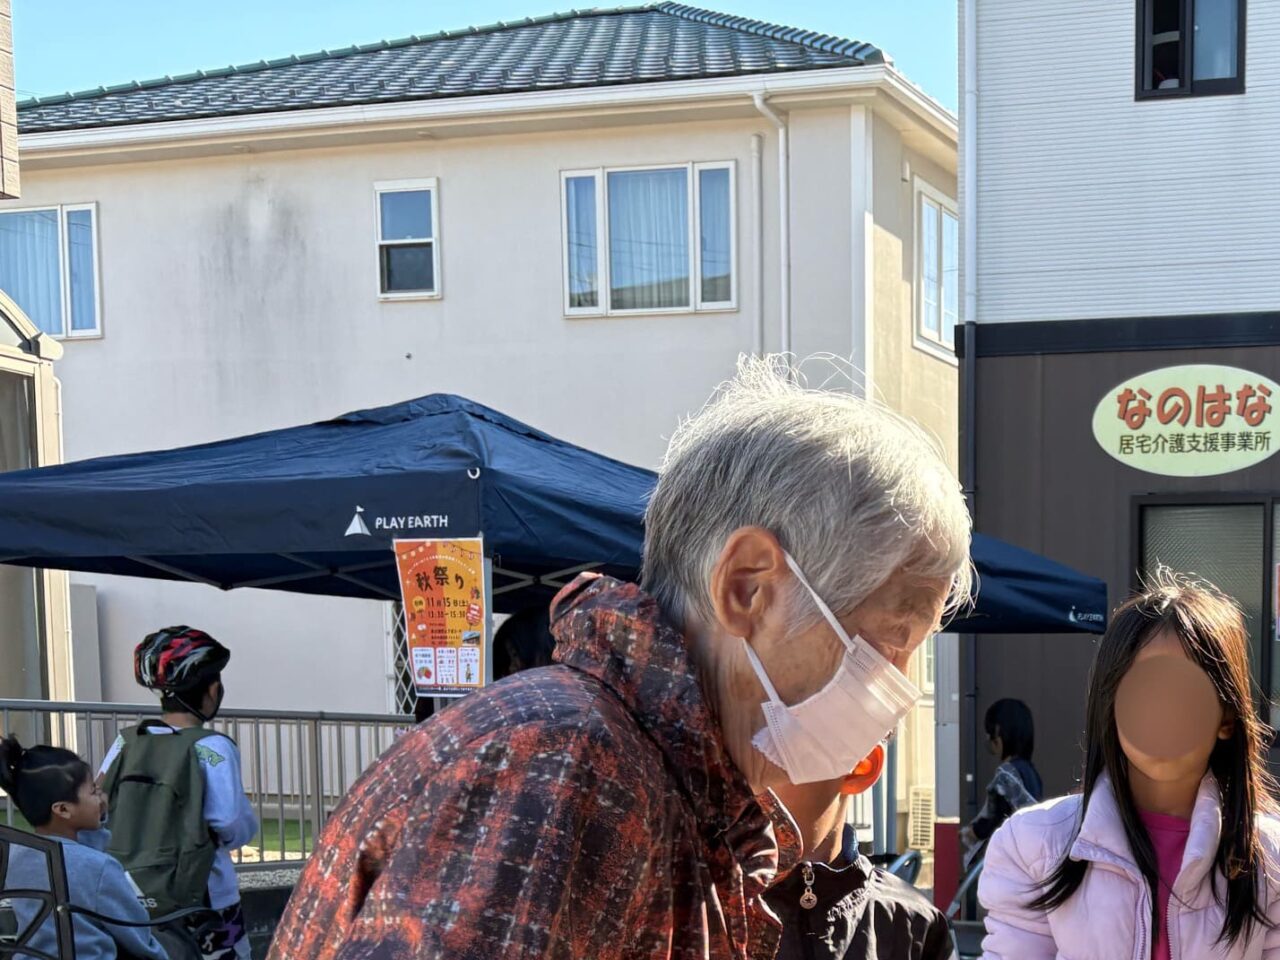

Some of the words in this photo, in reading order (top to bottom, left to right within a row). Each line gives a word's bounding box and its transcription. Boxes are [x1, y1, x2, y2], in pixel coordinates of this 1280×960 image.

[1116, 384, 1273, 430] なのはな
[1118, 431, 1272, 455] 居宅介護支援事業所
[375, 516, 406, 529] PLAY
[407, 515, 449, 528] EARTH
[415, 565, 465, 592] 秋祭り
